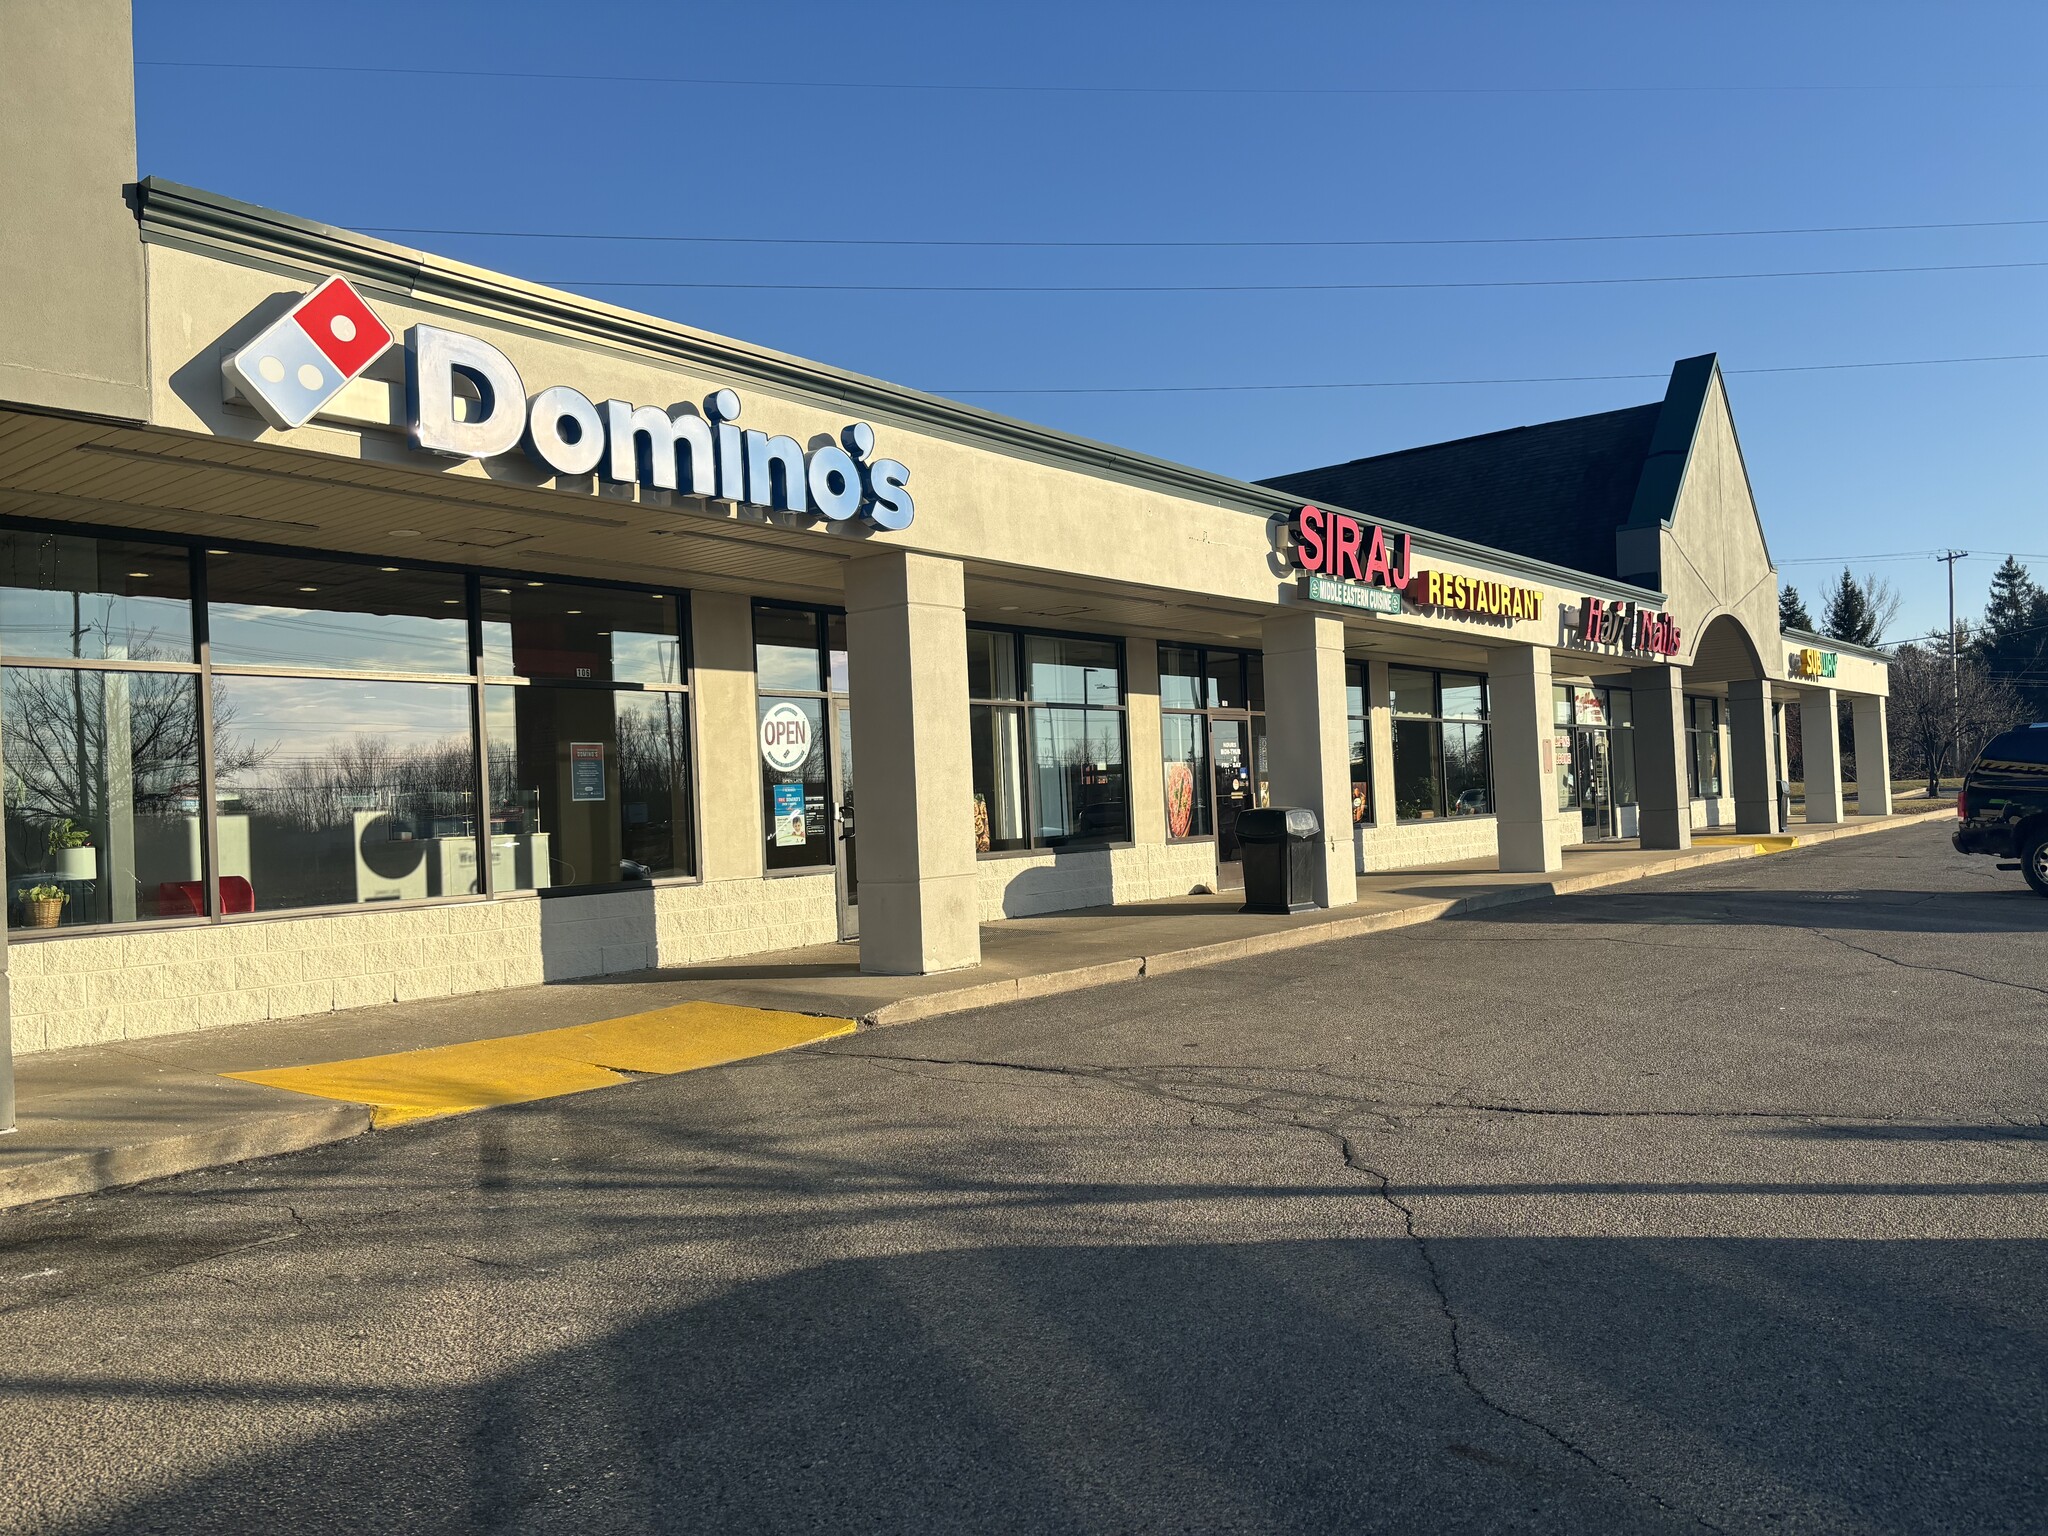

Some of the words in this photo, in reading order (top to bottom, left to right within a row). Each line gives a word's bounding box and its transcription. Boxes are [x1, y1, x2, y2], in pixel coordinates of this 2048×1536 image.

[410, 322, 915, 532] Domino's
[1298, 505, 1411, 590] SIRAJ
[1319, 580, 1342, 602] MIDDLE
[1343, 583, 1369, 607] EASTERN
[1370, 591, 1392, 612] CUISINE
[1428, 570, 1544, 621] RESTAURANT
[1585, 597, 1632, 646] Hair
[1638, 609, 1682, 657] Nails
[764, 720, 806, 746] OPEN
